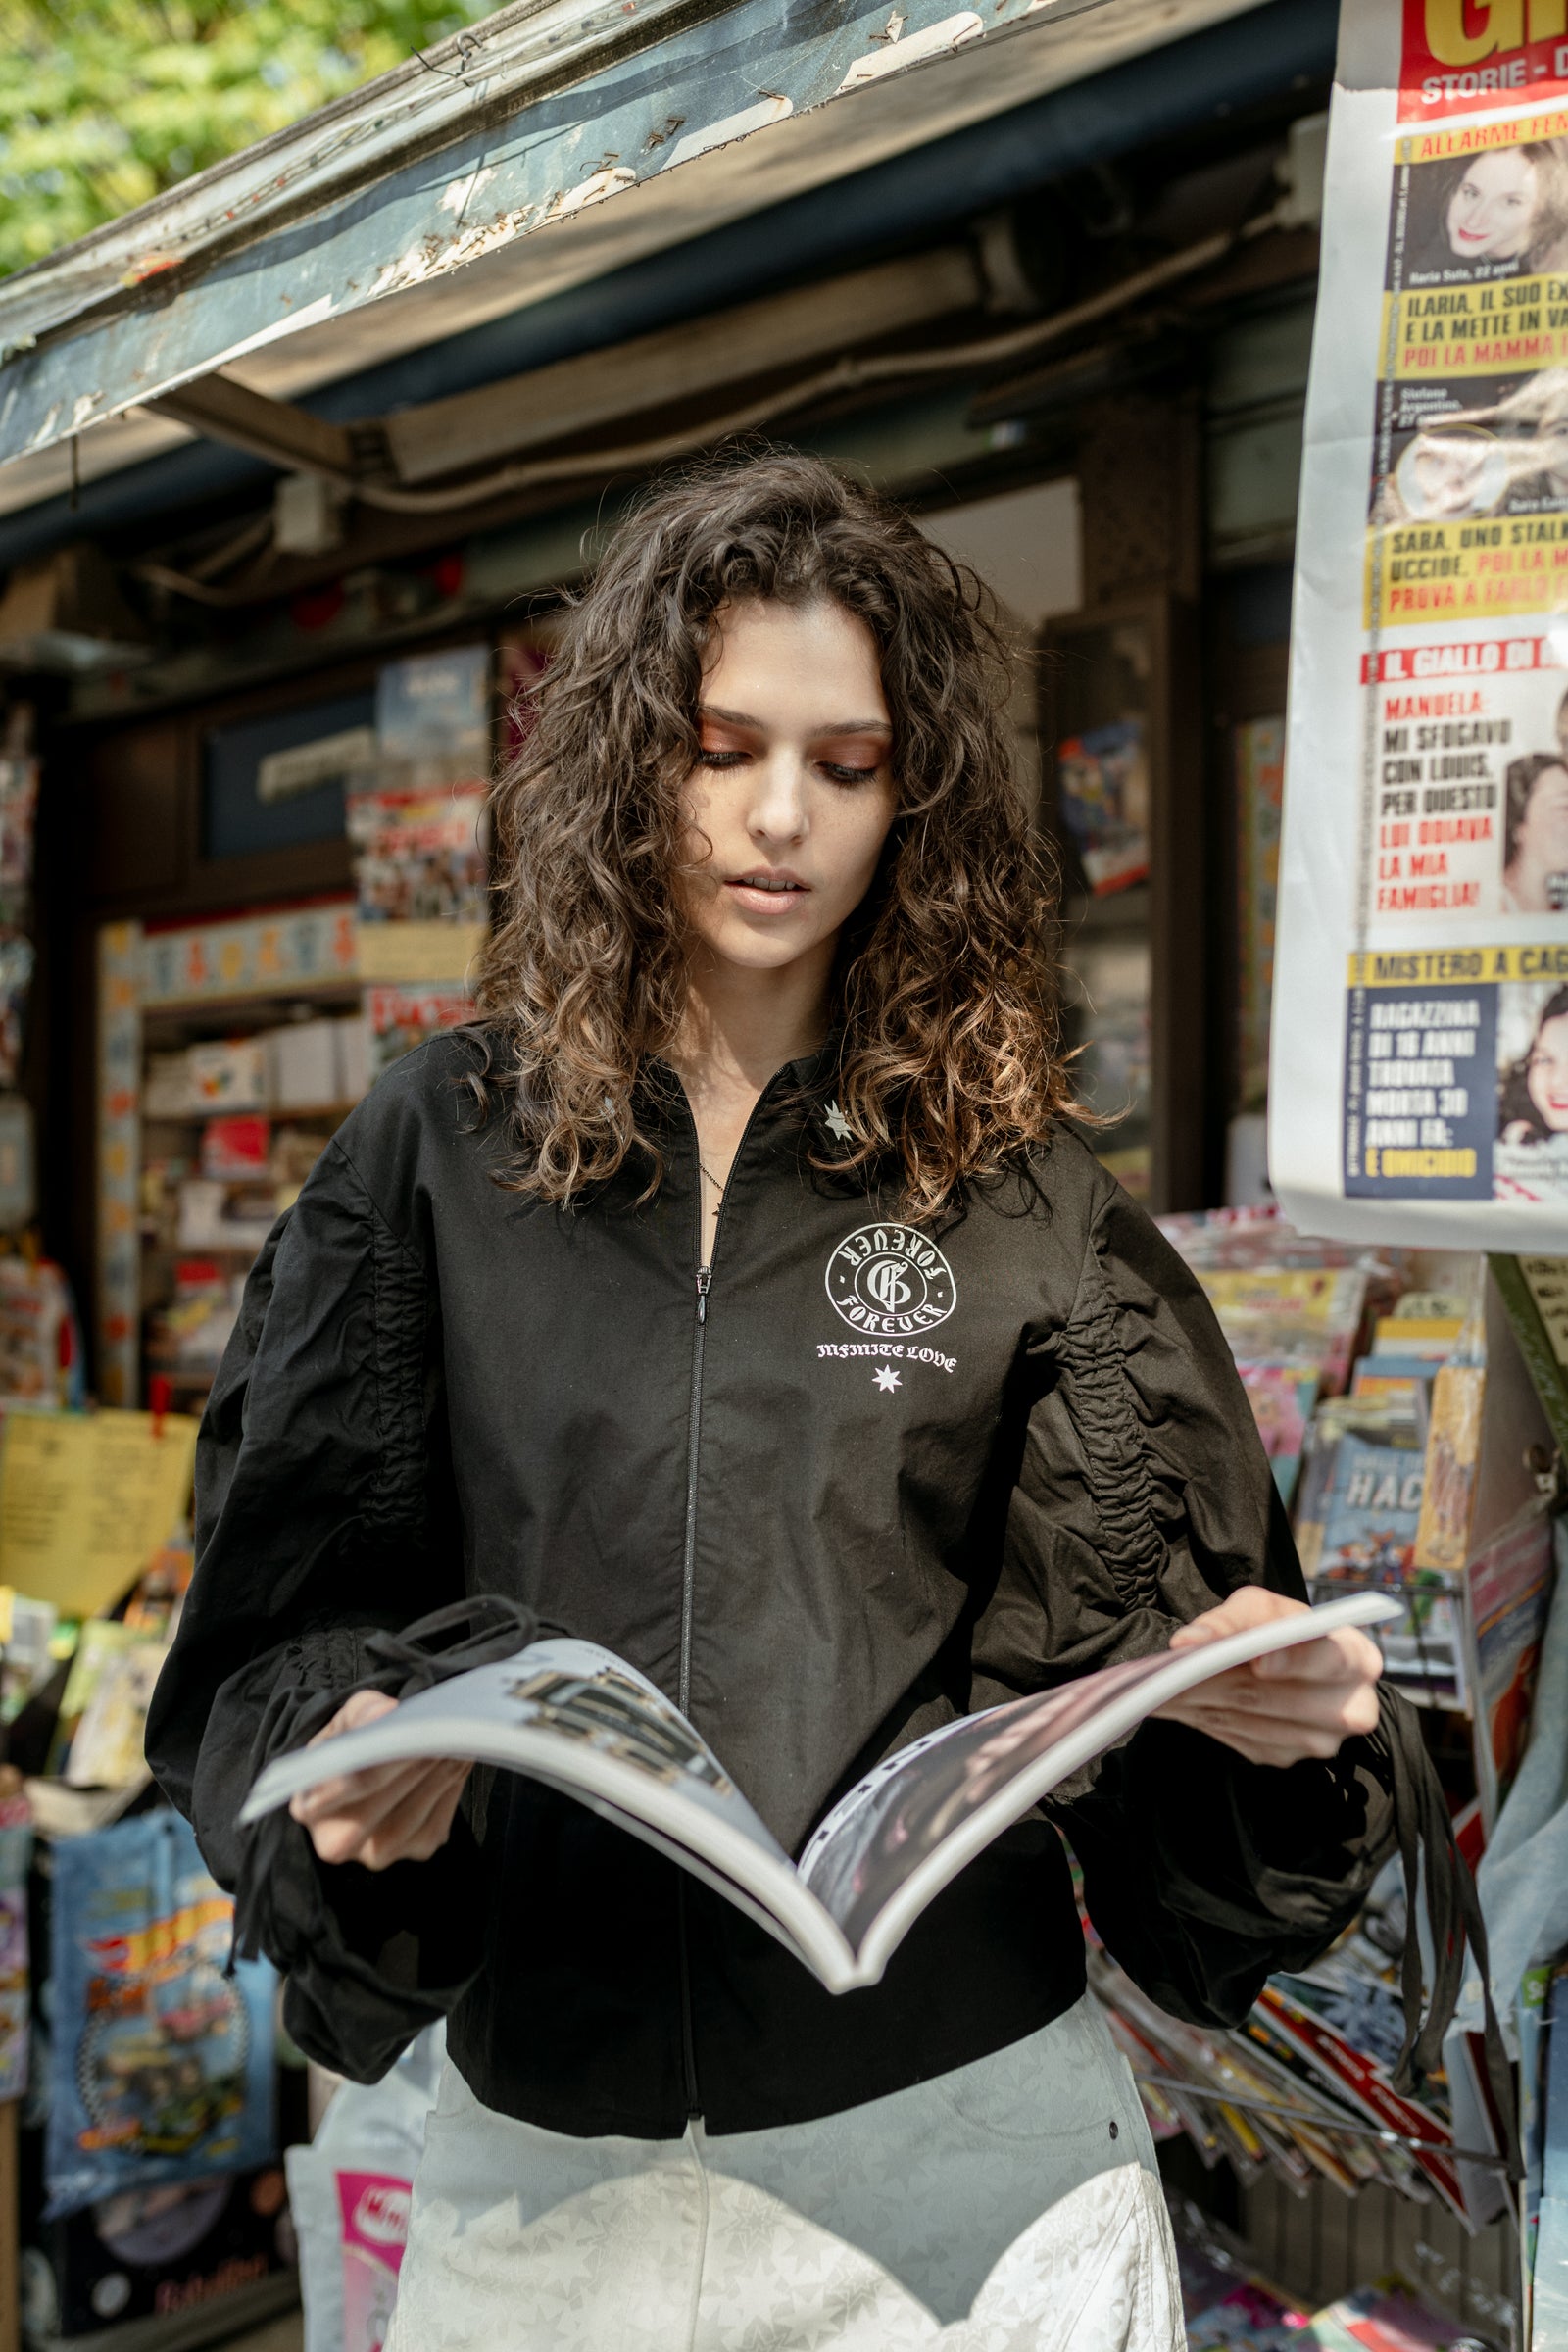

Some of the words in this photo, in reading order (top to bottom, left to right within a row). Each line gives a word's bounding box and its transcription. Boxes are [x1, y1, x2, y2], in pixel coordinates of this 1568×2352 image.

[1421, 58, 1526, 104] STORIE
[1421, 122, 1519, 157] ALLARME
[1481, 289, 1494, 311] IL
[1503, 281, 1541, 308] SUO
[1405, 321, 1414, 342] E
[1422, 321, 1444, 341] LA
[1452, 314, 1509, 339] METTE
[1519, 310, 1540, 332] IN
[1404, 345, 1437, 368] POI
[1444, 344, 1466, 367] LA
[1474, 334, 1553, 364] MAMMA
[1460, 526, 1502, 549] UNO
[1390, 583, 1456, 612] PROVA
[1462, 580, 1476, 606] A
[1384, 651, 1408, 679] IL
[1413, 642, 1500, 677] GIALLO
[1417, 720, 1511, 750] SFOGAVO
[1383, 759, 1422, 785] CON
[1380, 789, 1417, 817] PER
[1425, 784, 1496, 813] QUESTO
[1379, 855, 1401, 880] LA
[1375, 951, 1483, 979] MISTERO
[1494, 950, 1508, 975] A
[836, 1295, 948, 1332] FOREVER
[816, 1343, 905, 1359] INFINITE
[906, 1346, 958, 1373] LOVE
